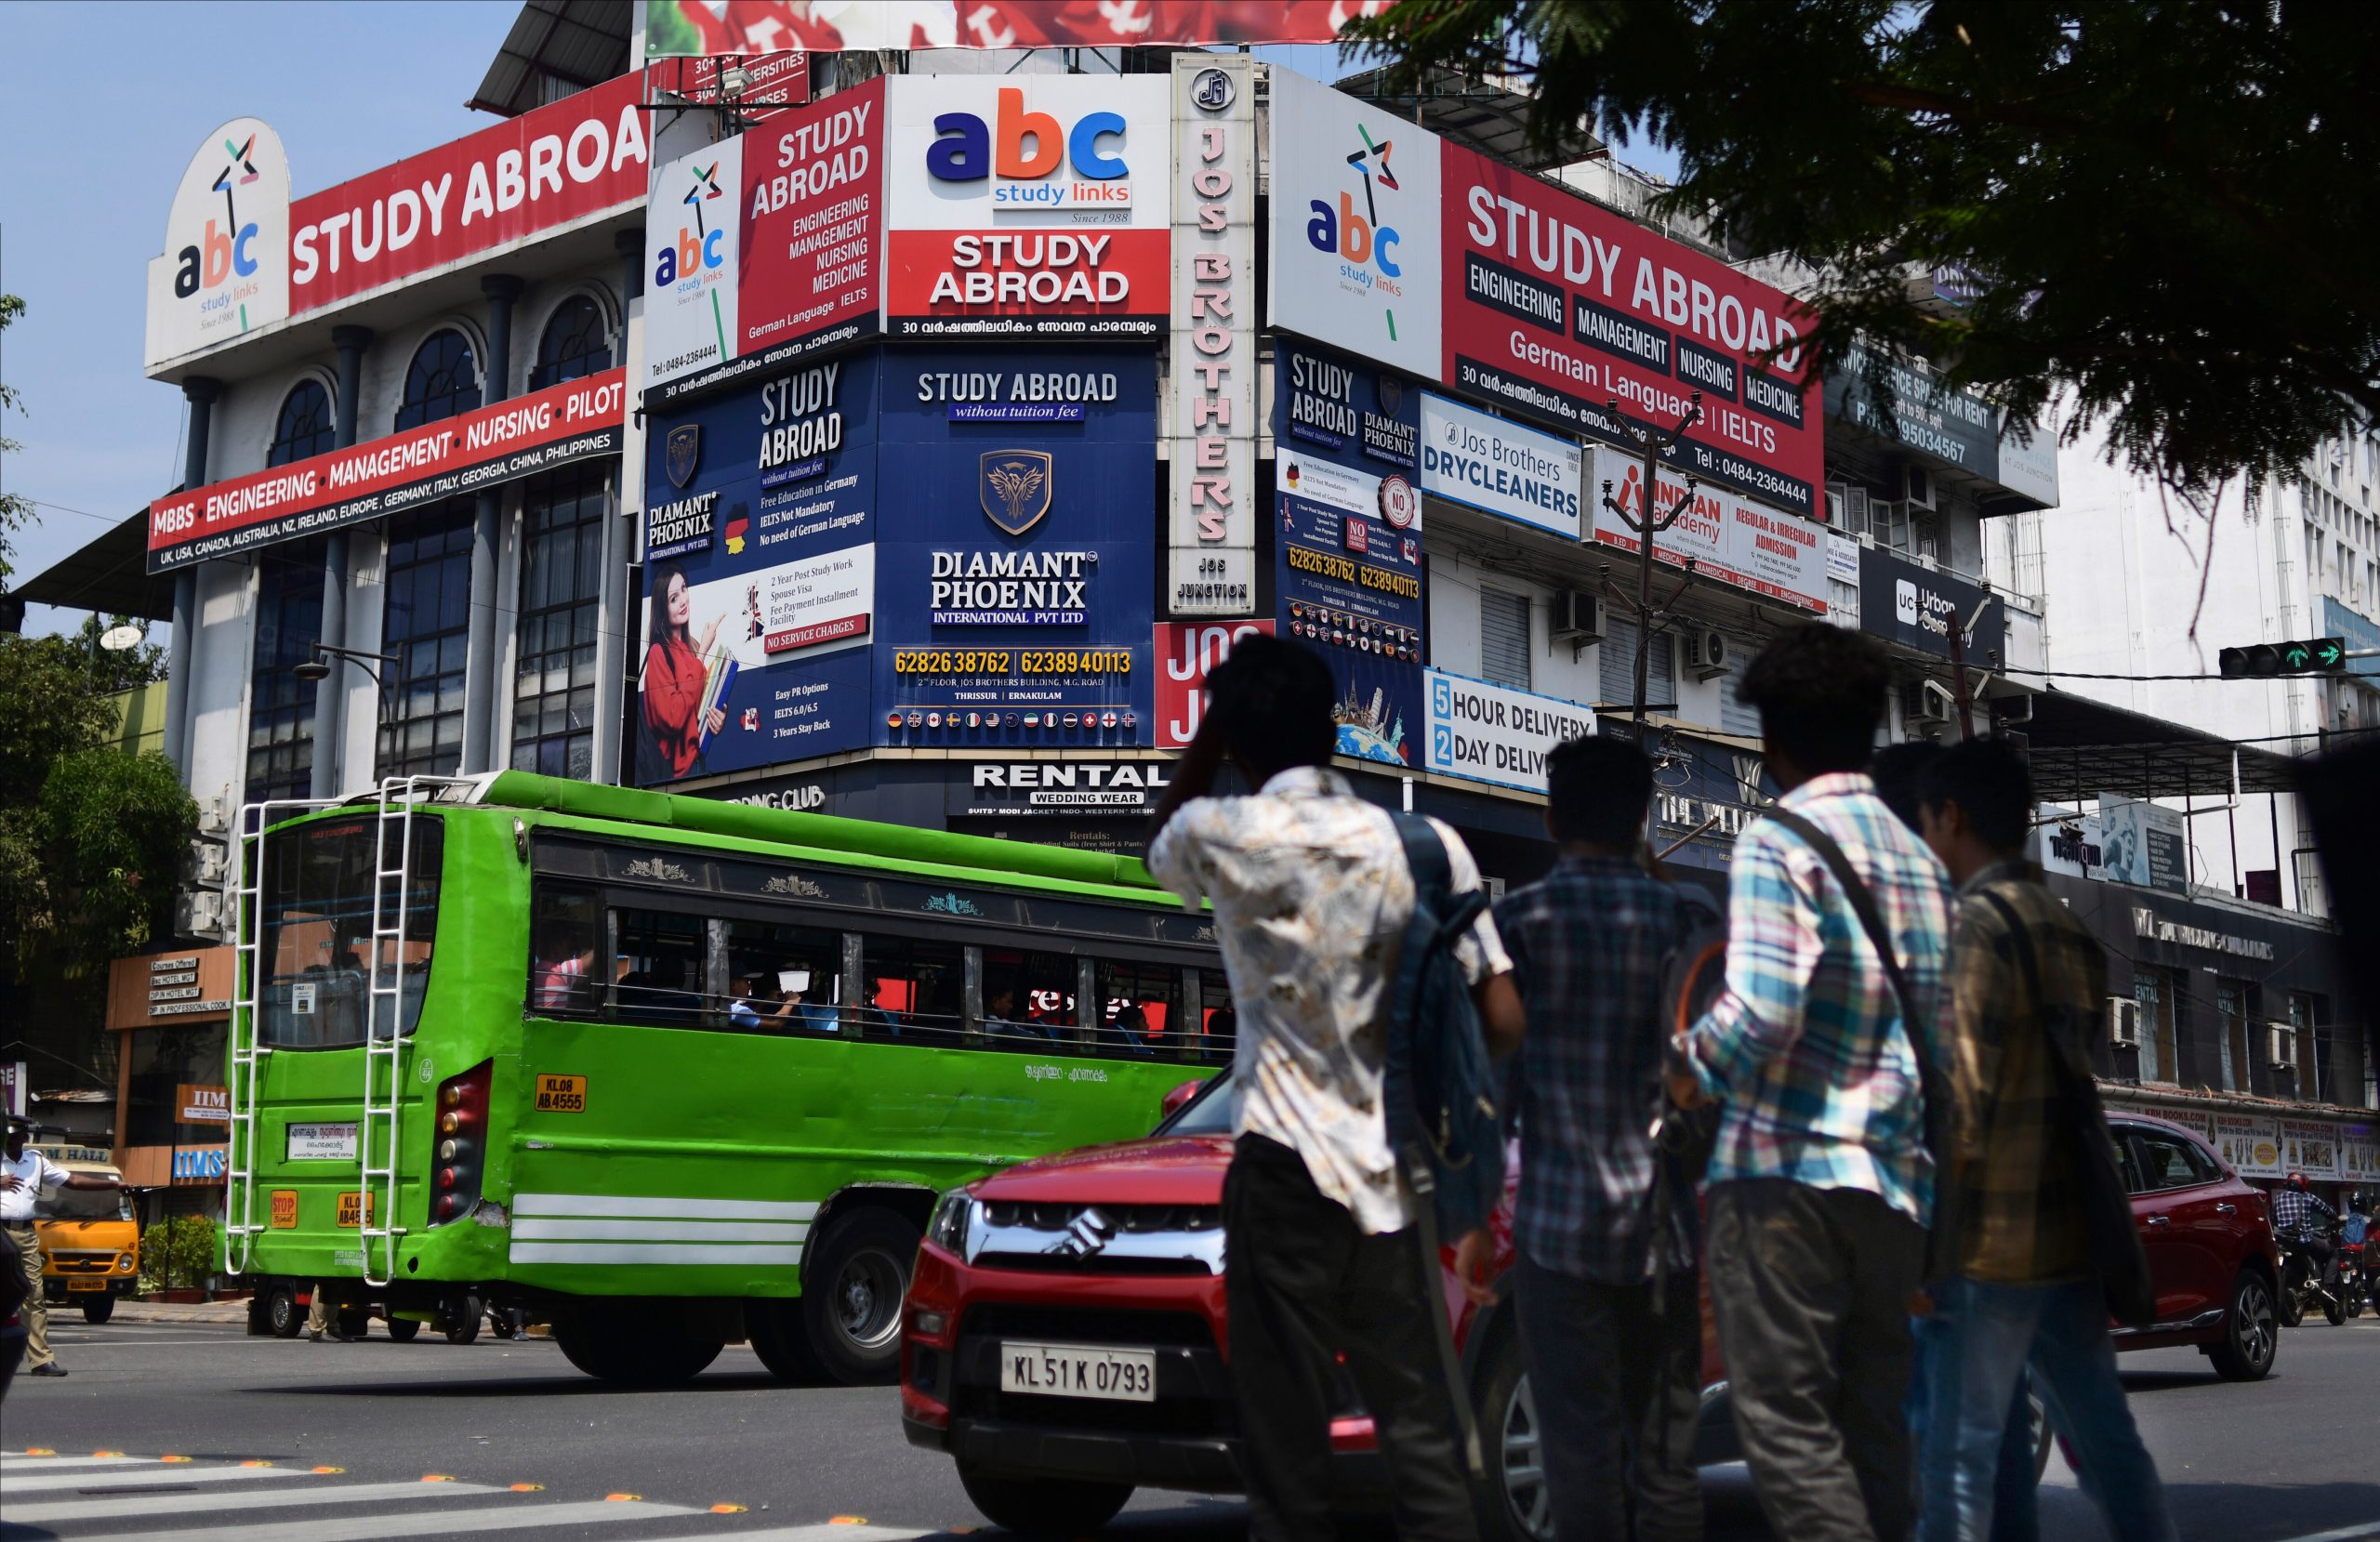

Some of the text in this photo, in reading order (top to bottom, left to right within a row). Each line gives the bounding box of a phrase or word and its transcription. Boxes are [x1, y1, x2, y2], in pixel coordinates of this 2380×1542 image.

[777, 100, 871, 168] STUDY
[926, 87, 1130, 180] abc
[292, 104, 647, 285] STUDY ABROA
[751, 145, 868, 219] ABROAD
[995, 183, 1129, 206] study links
[792, 194, 869, 237] ENGINEERING
[789, 216, 869, 260] MANAGEMENT
[952, 235, 1111, 268] STUDY
[1307, 191, 1402, 278] abc
[175, 219, 258, 299] abc
[655, 228, 723, 287] abc
[816, 238, 867, 271] NURSING
[678, 270, 723, 294] study links
[813, 259, 867, 296] MEDICINE
[930, 271, 1130, 305] ABROAD
[1340, 263, 1402, 297] study links
[1467, 185, 1801, 374] STUDY ABROAD
[201, 283, 258, 314] study links
[749, 288, 867, 339] German Language IELTS
[903, 322, 918, 333] 30
[1038, 322, 1084, 333] സേവന
[1471, 263, 1562, 325] ENGINEERING
[1578, 307, 1667, 365] MANAGEMENT
[1680, 347, 1733, 393] NURSING
[1746, 375, 1801, 420] MEDICINE
[666, 387, 677, 398] 30
[764, 343, 801, 364] സേവന
[918, 373, 1117, 402] STUDY ABROAD
[1292, 353, 1353, 402] STUDY
[761, 362, 839, 426] STUDY
[1510, 330, 1607, 387] German
[1605, 364, 1705, 428] Language
[1722, 409, 1776, 454] IELTS
[956, 405, 1078, 420] without tuition fee
[1292, 391, 1355, 436] ABROAD
[1365, 412, 1415, 441] DIAMANT
[759, 412, 841, 469] ABROAD
[1365, 428, 1415, 456] PHOENIX
[1461, 427, 1560, 481] Jos Brothers
[153, 382, 623, 537] MBBS ENGINEERING MANAGEMENT NURSING PILOT
[761, 461, 823, 486] without tuition fee
[760, 474, 858, 509] Free Education in Germany
[1423, 444, 1578, 518] DRYCLEANERS
[160, 550, 175, 566] UK,
[175, 545, 194, 561] USA,
[194, 535, 231, 556] CANADA,
[232, 523, 280, 547] AUSTRALIA,
[282, 520, 297, 535] NZ,
[298, 508, 337, 532] IRELAND,
[384, 481, 433, 507] GERMANY,
[433, 476, 459, 496] ITALY,
[461, 461, 509, 485] GEORGIA,
[509, 453, 544, 472] CHINA,
[545, 433, 611, 463] PHILIPPINES
[649, 494, 711, 526] DIAMANT
[760, 499, 836, 528] IELTS Not Mandatory
[1393, 493, 1405, 511] NO
[648, 513, 711, 547] PHOENIX
[760, 511, 865, 547] No need of German Language
[1350, 521, 1365, 537] NO
[1736, 507, 1816, 548] REGULAR & IRREGULAR
[1755, 534, 1797, 560] ADMISSION
[932, 551, 1086, 578] DIAMANT
[1198, 558, 1225, 572] JOS
[771, 587, 858, 615] Fee Payment Installment
[932, 581, 1086, 609] PHOENIX
[1178, 584, 1247, 599] JUNCTION
[767, 620, 854, 649] NO SERVICE CHARGES
[770, 613, 796, 626] Facility
[933, 612, 1084, 624] INTERNATIONAL PVT LTD
[954, 692, 1062, 700] THRISSUR ERNAKULAM
[1435, 684, 1448, 712] 5
[1453, 691, 1506, 727] HOUR
[1513, 705, 1591, 742] DELIVERY
[1436, 729, 1449, 760] 2
[1455, 736, 1489, 766] DAY
[973, 765, 1171, 787] RENTAL
[1036, 794, 1138, 803] WEDDING WEAR
[166, 1003, 208, 1012] PROFESSIONAL
[211, 1001, 226, 1009] COOK
[273, 1196, 295, 1213] STOP
[1096, 1362, 1150, 1392] 0793
